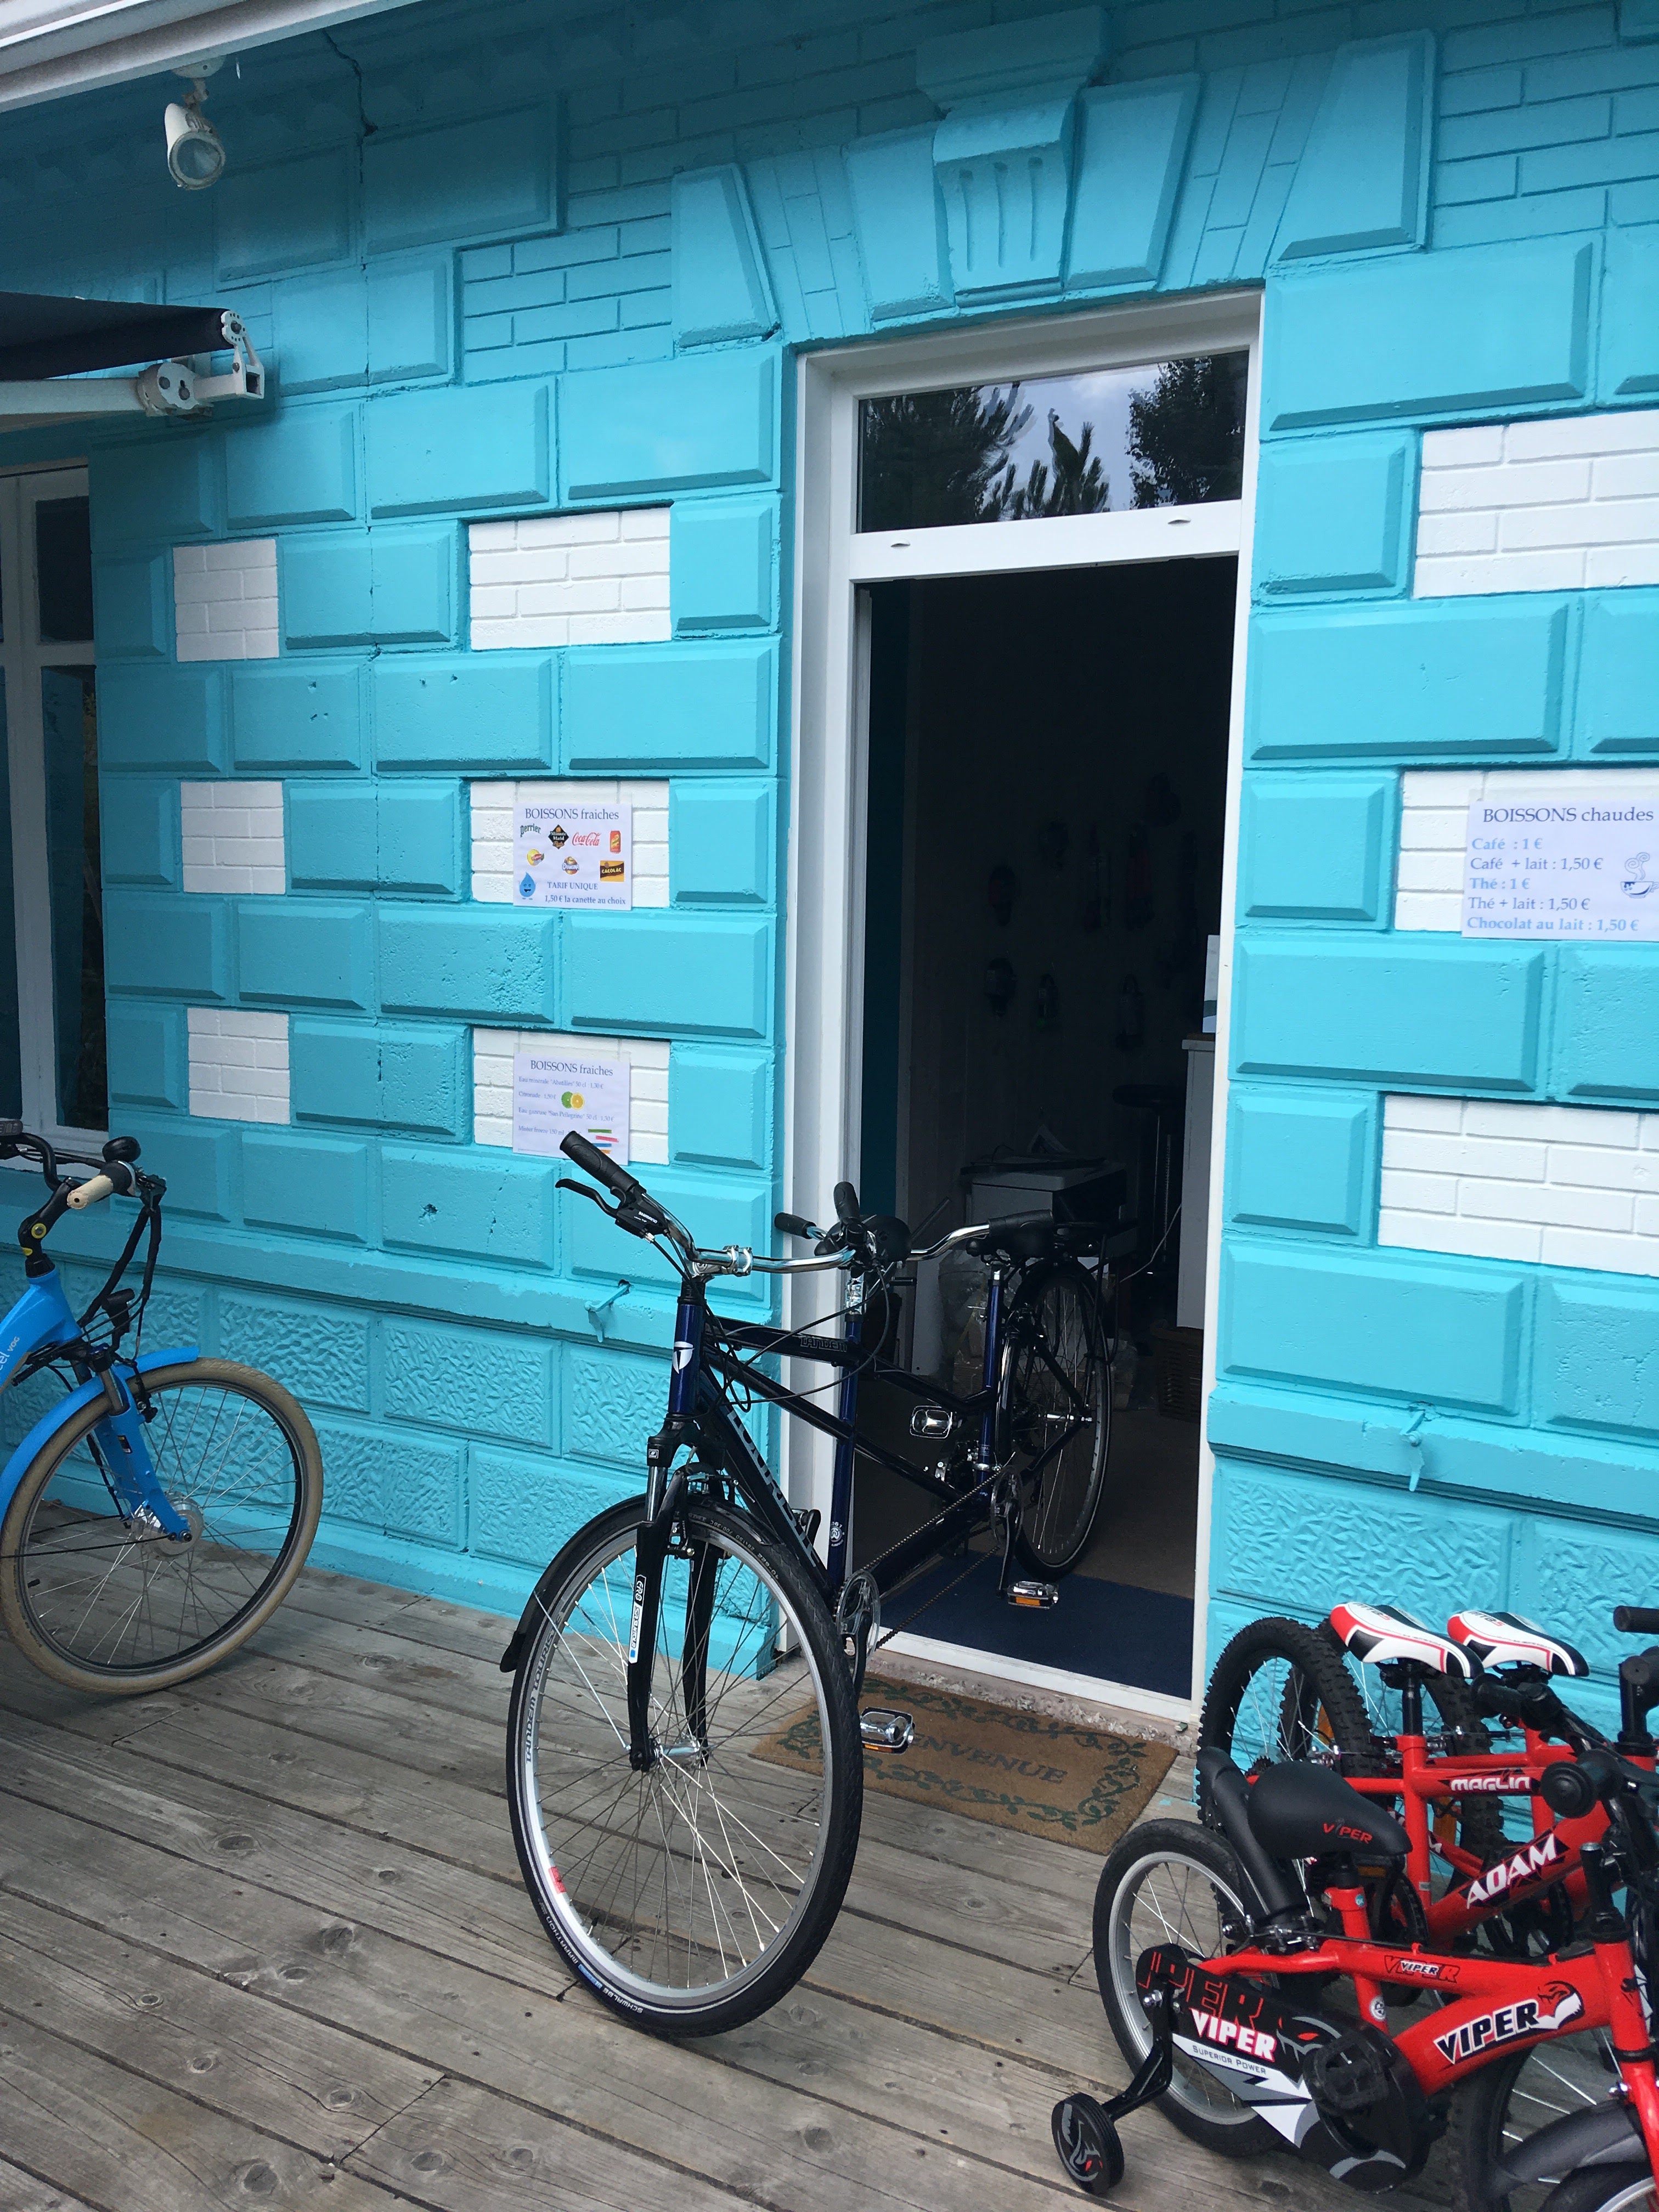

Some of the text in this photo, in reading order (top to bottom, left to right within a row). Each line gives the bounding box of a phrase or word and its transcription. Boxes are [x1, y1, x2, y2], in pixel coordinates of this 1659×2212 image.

[525, 808, 619, 820] BOISSONS fraiches
[1483, 806, 1654, 822] BOISSONS chaudes
[1471, 837, 1506, 850] Café
[1522, 838, 1530, 850] 1
[1534, 838, 1543, 850] €
[1470, 857, 1503, 870] Café
[1511, 859, 1521, 868] +
[1525, 857, 1549, 870] lait
[1561, 857, 1590, 872] 1,50
[1594, 857, 1604, 870] €
[570, 883, 598, 891] UNIQUE
[1469, 877, 1498, 889] Thé
[1510, 878, 1516, 889] 1
[1521, 878, 1531, 889] €
[1468, 896, 1495, 909] Thé
[1499, 899, 1509, 907] +
[1513, 898, 1536, 910] lait
[1548, 898, 1577, 911] 1,50
[1581, 898, 1590, 910] €
[1467, 917, 1532, 930] Chocolat
[1536, 921, 1554, 930] au
[1559, 918, 1584, 930] lait
[1596, 919, 1627, 932] 1,50
[1630, 919, 1639, 931] €
[531, 1060, 613, 1076] BOISSONS fraiches
[911, 1733, 1068, 1783] ENVENUE
[1467, 1833, 1557, 1910] ADAM
[1400, 1960, 1440, 1975] VIPER
[1189, 2007, 1277, 2062] VIPER
[1434, 1999, 1539, 2064] VIPER
